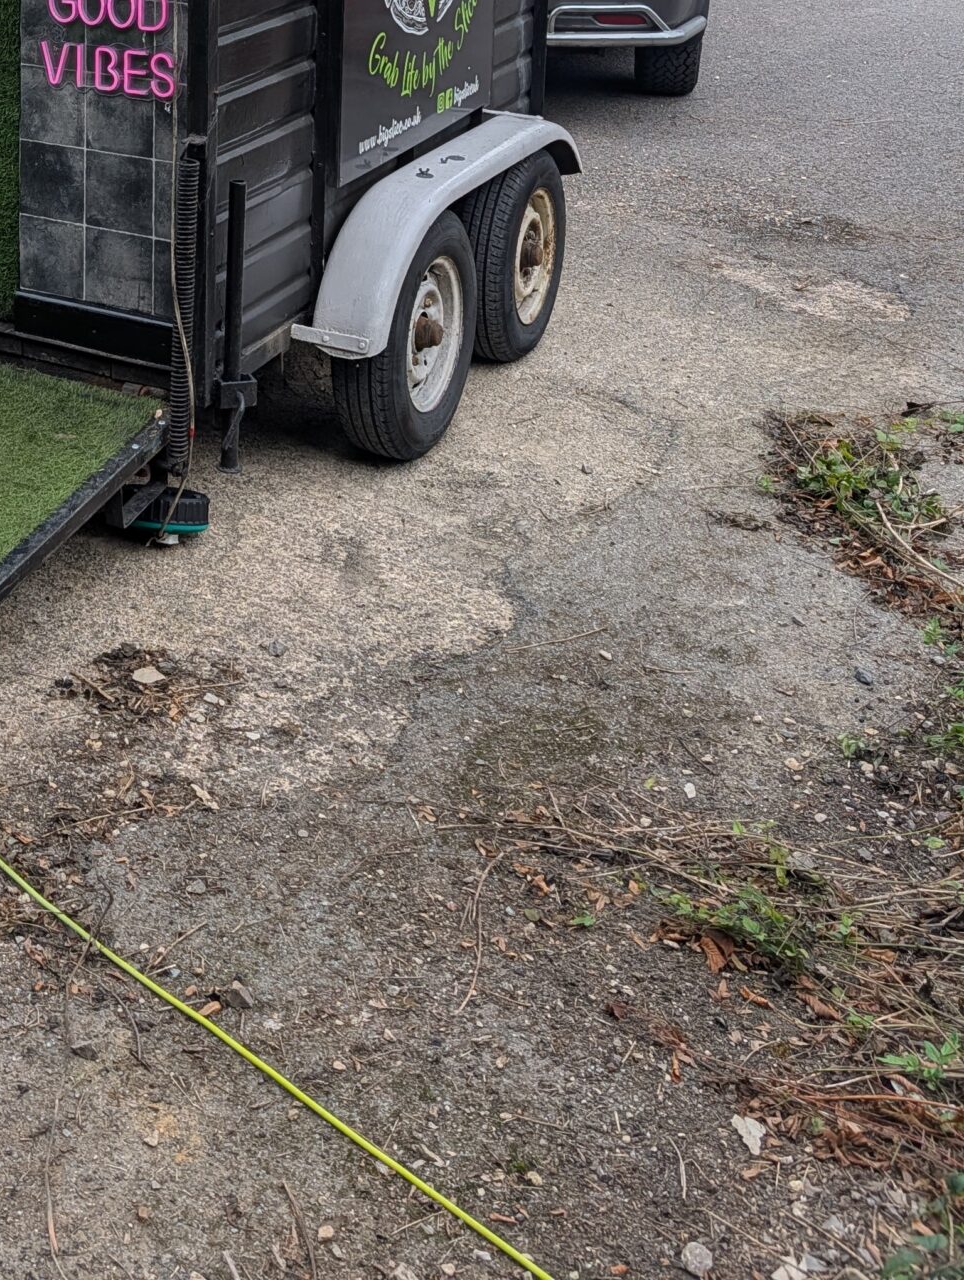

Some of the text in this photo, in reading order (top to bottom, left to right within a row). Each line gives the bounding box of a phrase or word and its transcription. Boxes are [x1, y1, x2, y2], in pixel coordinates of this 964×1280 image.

[40, 39, 175, 99] VIBES
[368, 31, 400, 89] Grab
[400, 50, 420, 98] Life
[422, 51, 436, 98] by
[433, 36, 454, 76] the
